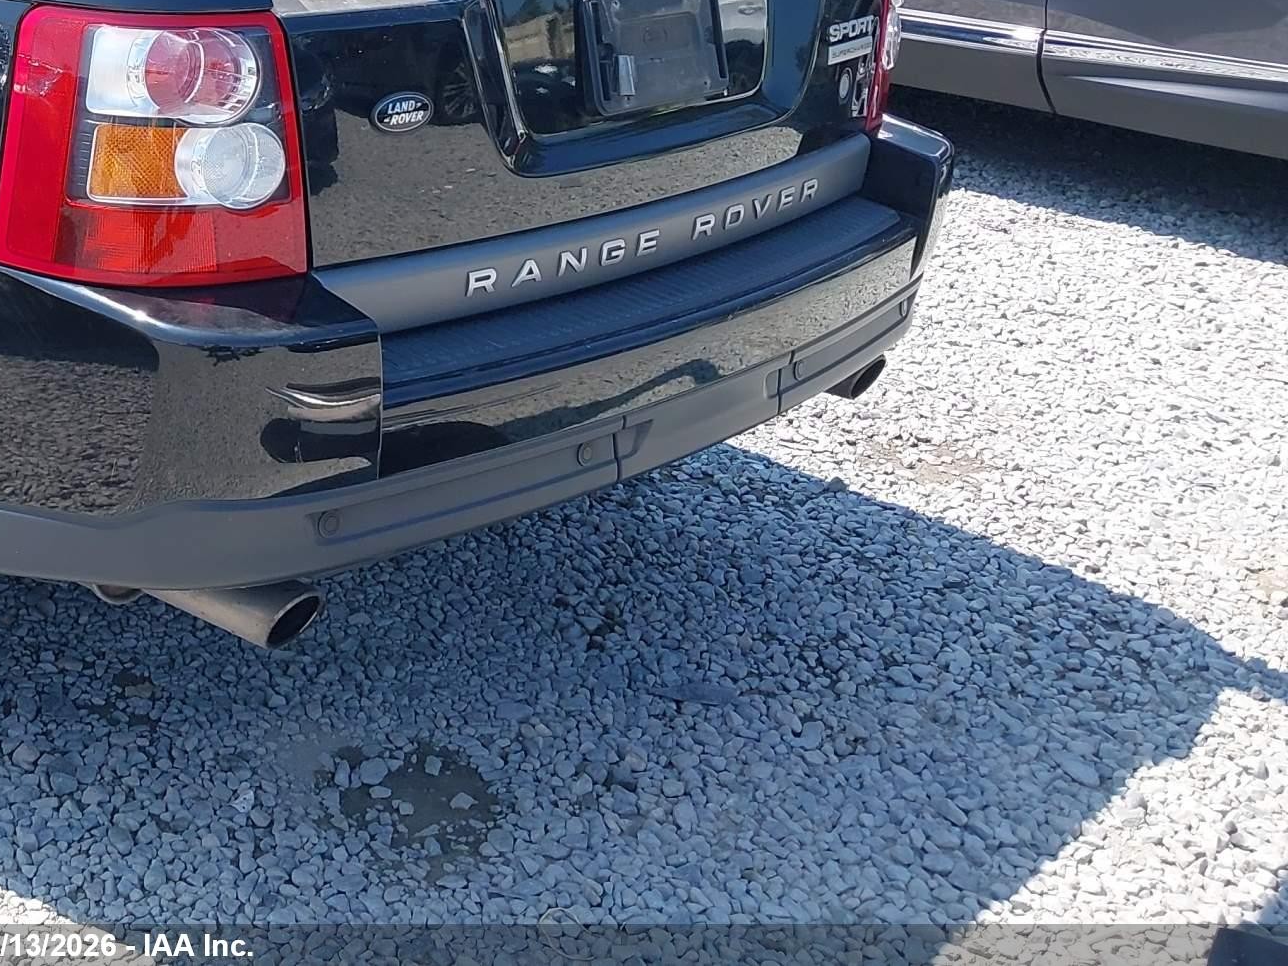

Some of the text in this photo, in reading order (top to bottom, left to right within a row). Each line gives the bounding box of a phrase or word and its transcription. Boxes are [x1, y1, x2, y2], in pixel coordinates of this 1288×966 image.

[829, 15, 874, 43] SPORT
[387, 100, 416, 115] LAND
[390, 110, 424, 126] ROVER
[465, 178, 819, 298] RANGE ROVER
